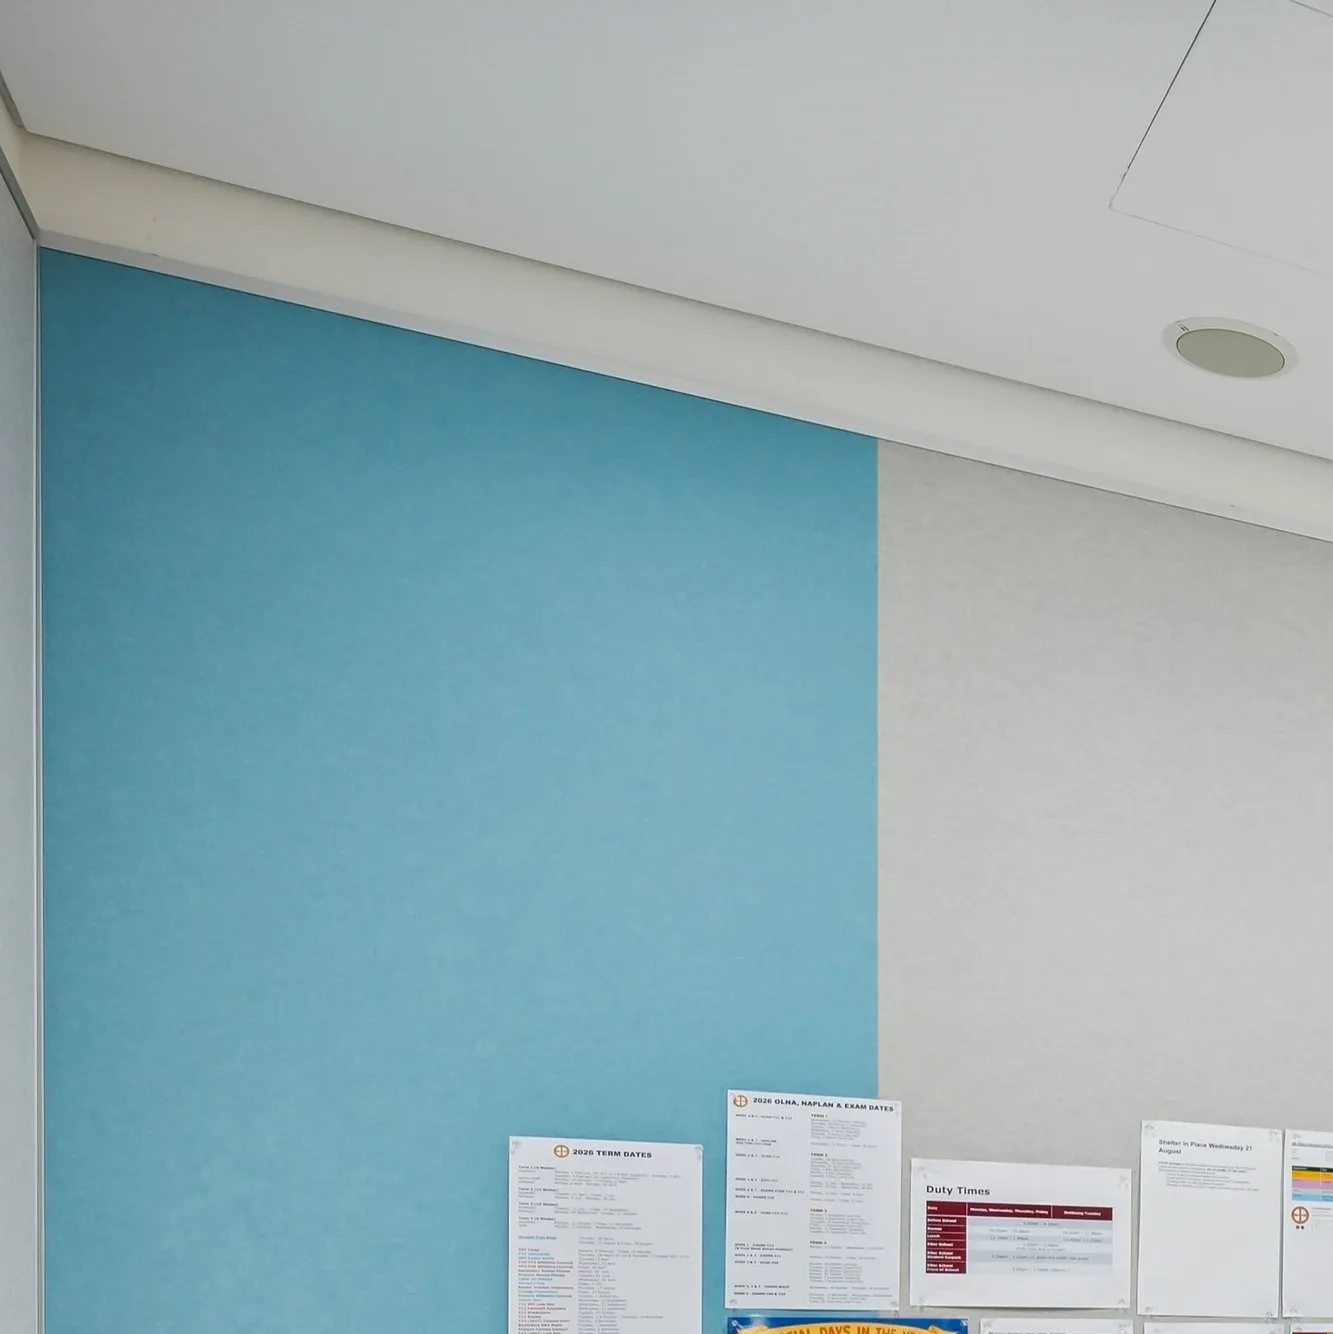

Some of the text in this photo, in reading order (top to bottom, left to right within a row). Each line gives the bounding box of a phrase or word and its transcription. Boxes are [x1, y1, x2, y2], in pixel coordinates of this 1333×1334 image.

[774, 1098, 800, 1107] OLNA,
[801, 1100, 834, 1108] NAPLAN
[844, 1102, 867, 1110] EXAM
[868, 1104, 894, 1112] DATES
[1208, 1143, 1244, 1151] Wednesday
[572, 1148, 594, 1156] 2026
[597, 1149, 621, 1157] TERM
[926, 1185, 991, 1196] Duty Times
